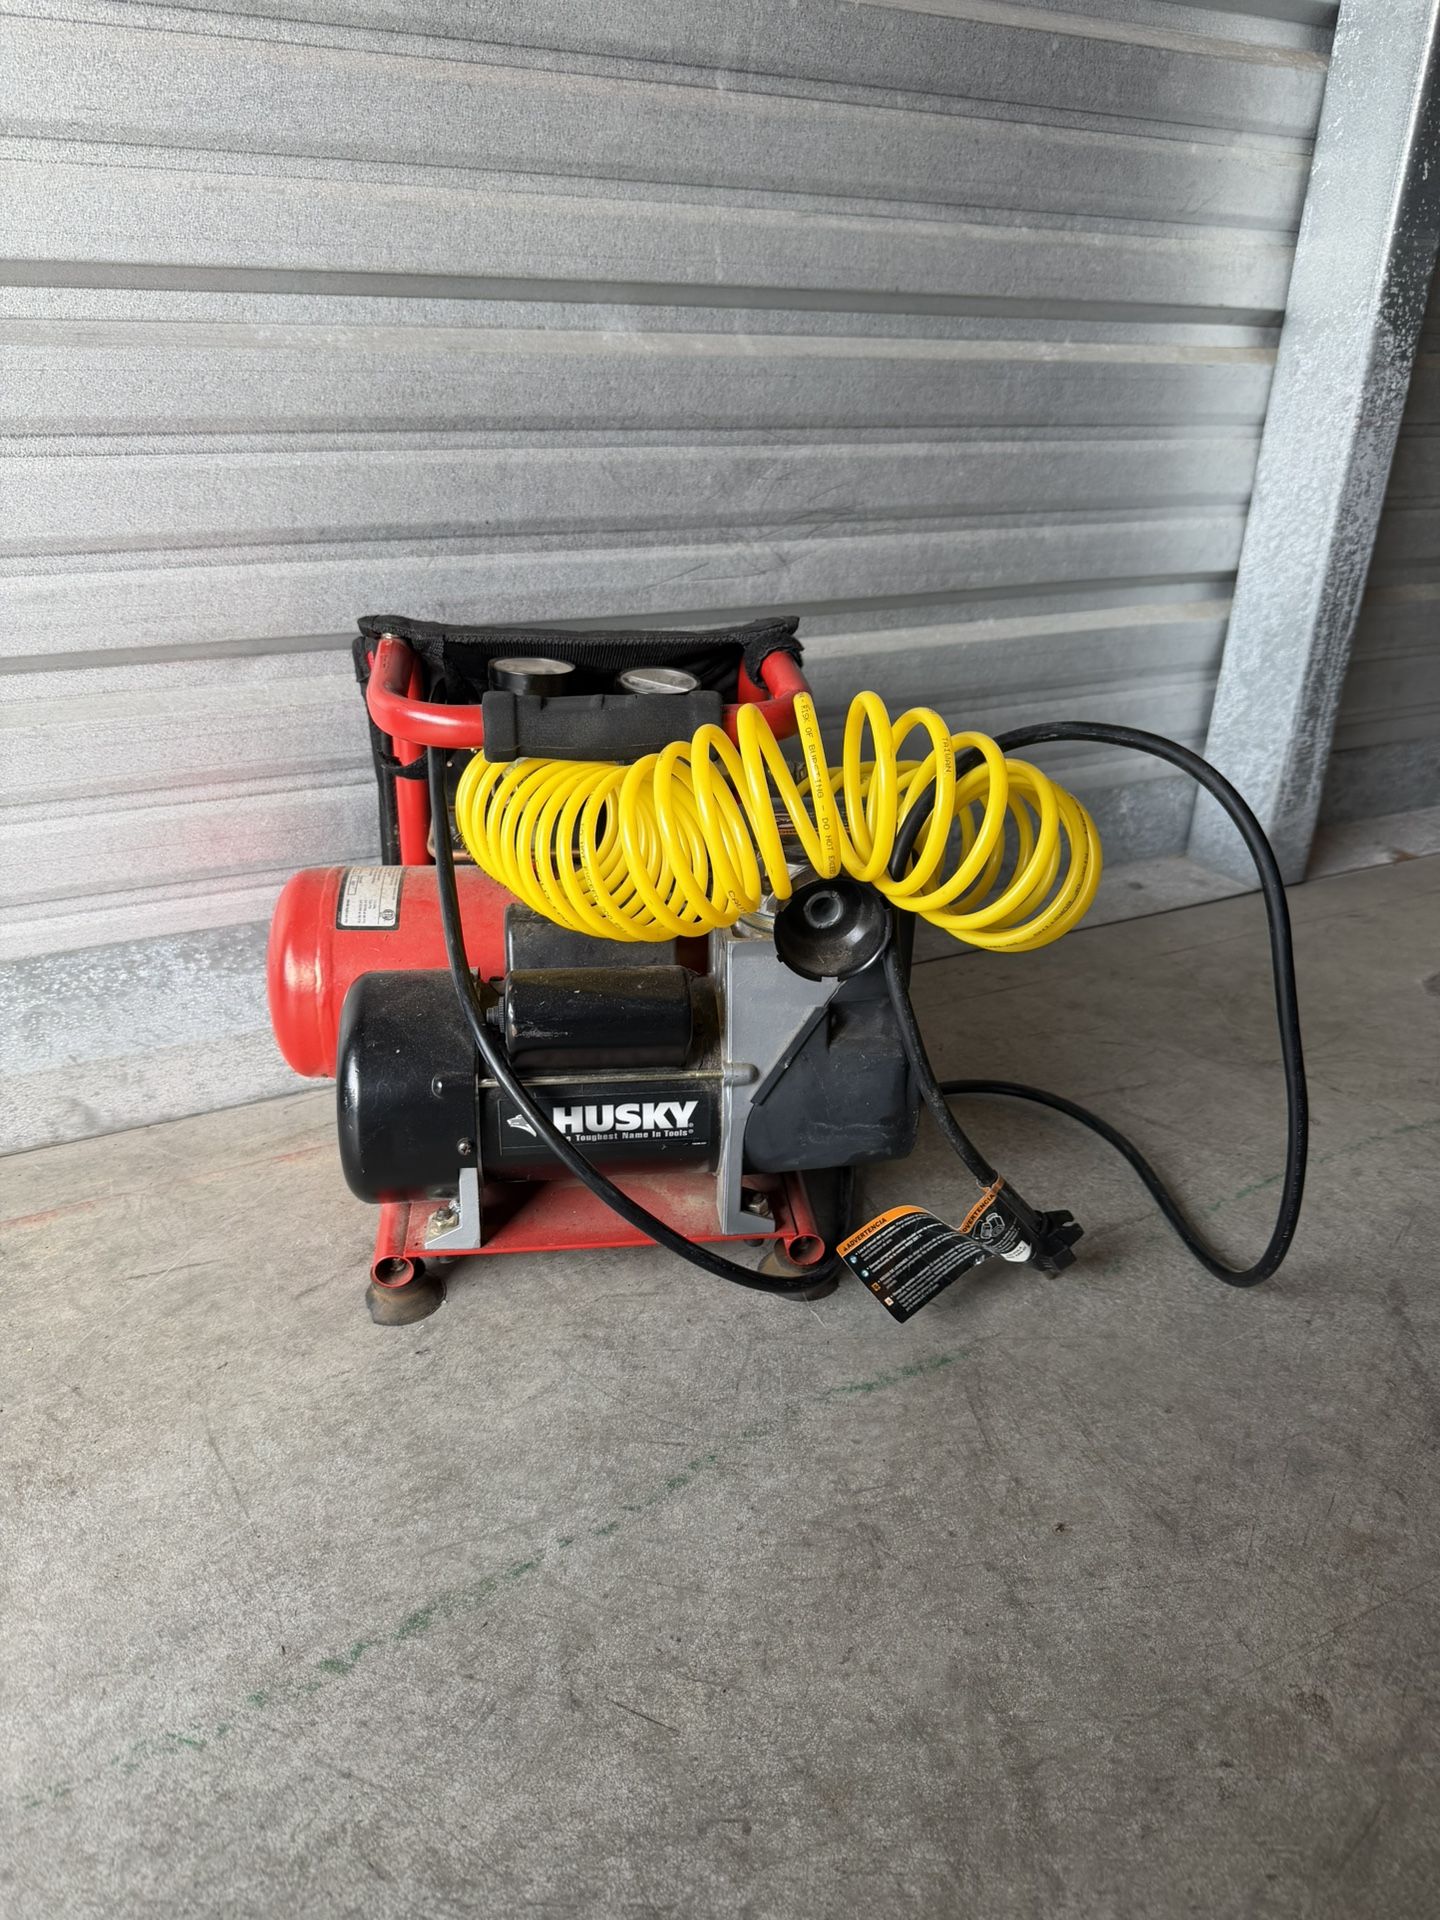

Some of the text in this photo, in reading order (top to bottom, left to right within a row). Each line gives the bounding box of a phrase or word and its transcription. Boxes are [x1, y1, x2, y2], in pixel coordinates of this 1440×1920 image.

[942, 737, 952, 773] TAIWAN
[822, 817, 830, 830] DO
[552, 1100, 698, 1134] HUSKY
[575, 1131, 619, 1142] Toughest
[621, 1130, 649, 1140] Name
[651, 1130, 662, 1138] In
[663, 1128, 688, 1138] Tools
[845, 1217, 888, 1250] ADVERTENCIA
